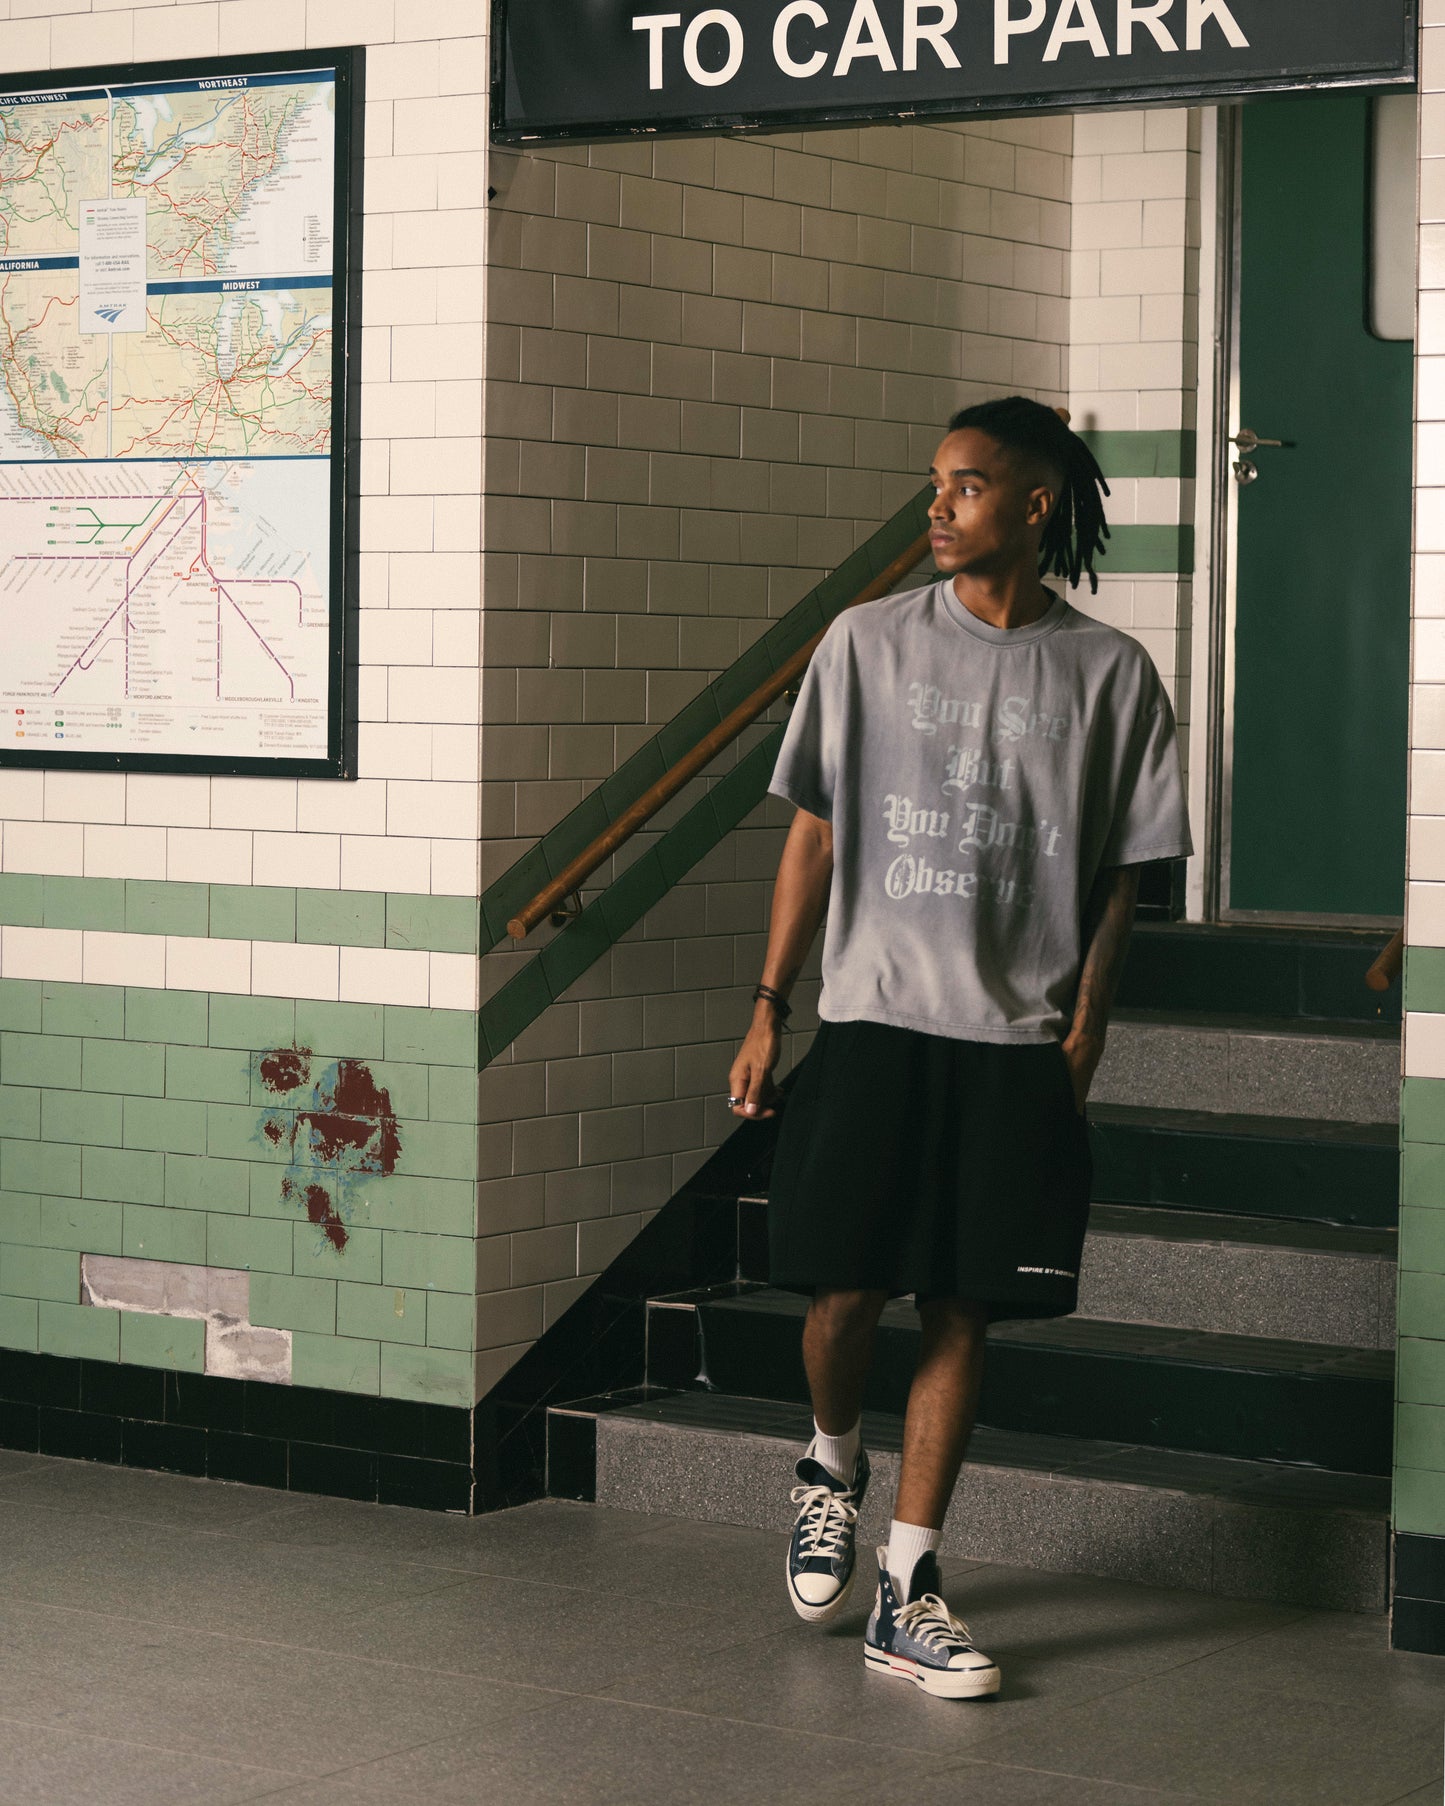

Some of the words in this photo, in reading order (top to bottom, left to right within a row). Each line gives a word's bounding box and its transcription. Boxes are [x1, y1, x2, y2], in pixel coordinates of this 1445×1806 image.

[631, 8, 744, 90] TO
[772, 0, 962, 78] CAR
[993, 0, 1250, 65] PARK
[19, 93, 68, 103] NORTHWEST
[198, 78, 248, 89] NORTHEAST
[222, 281, 260, 290] MIDWEST
[907, 682, 983, 736] You
[941, 744, 1016, 796] But
[882, 793, 951, 848] You
[884, 853, 1034, 906] Obsev
[1017, 1266, 1044, 1274] INSPIRE
